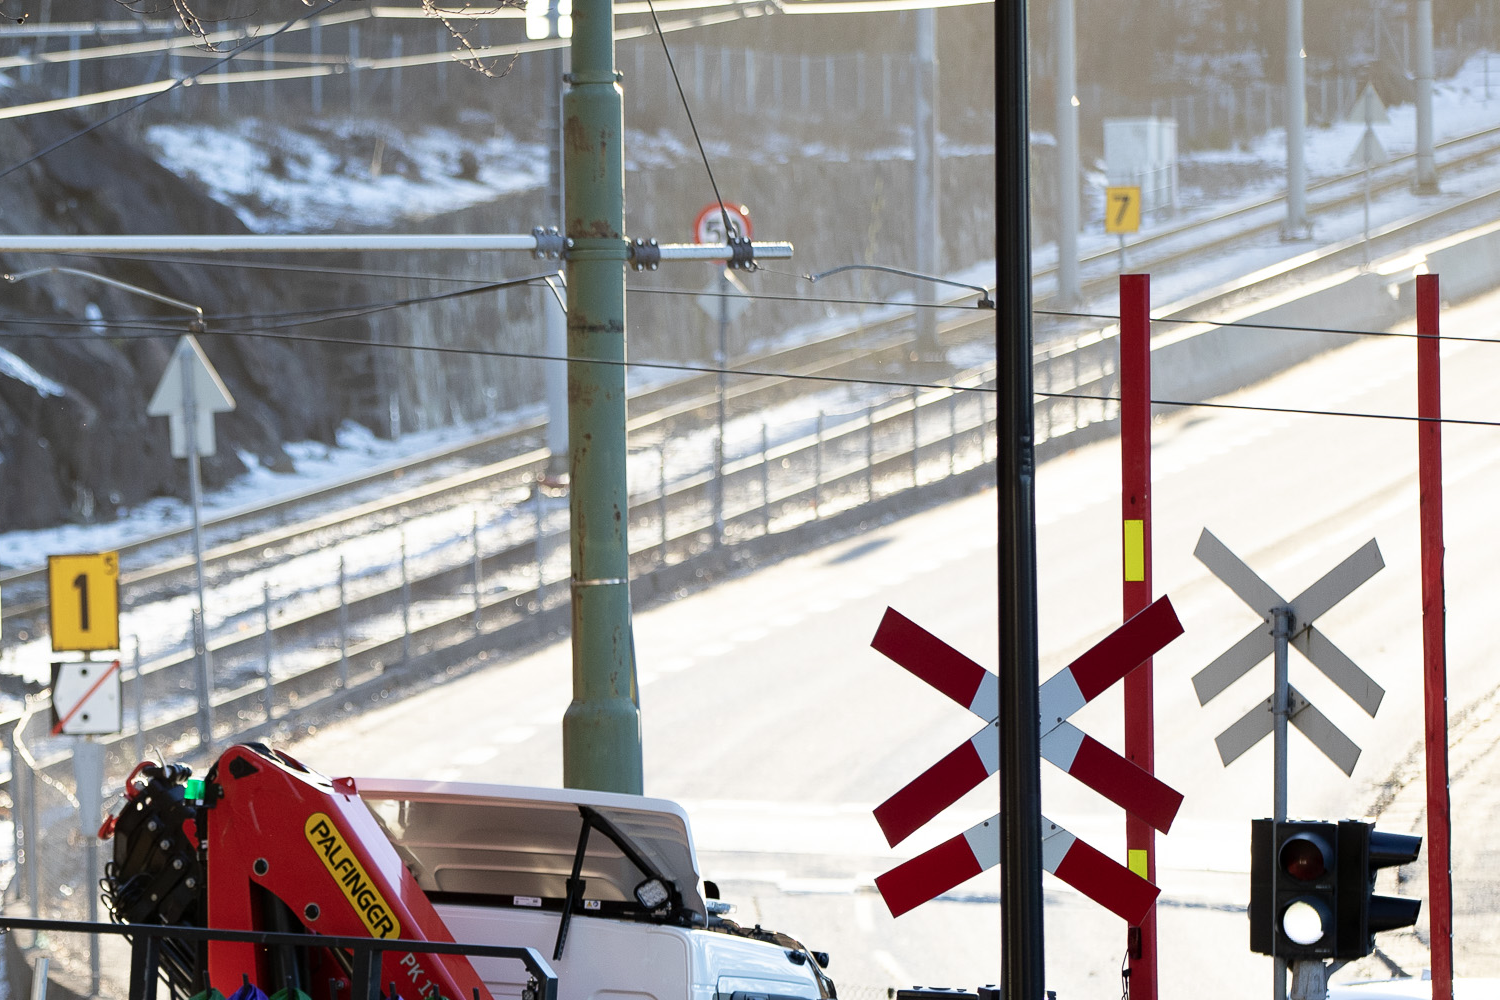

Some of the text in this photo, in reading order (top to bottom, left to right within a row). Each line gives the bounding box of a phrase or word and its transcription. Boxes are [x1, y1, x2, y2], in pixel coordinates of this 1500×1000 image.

[1112, 193, 1129, 227] 7
[73, 572, 90, 632] 1
[309, 819, 394, 939] PALFINGER
[400, 952, 425, 984] PK
